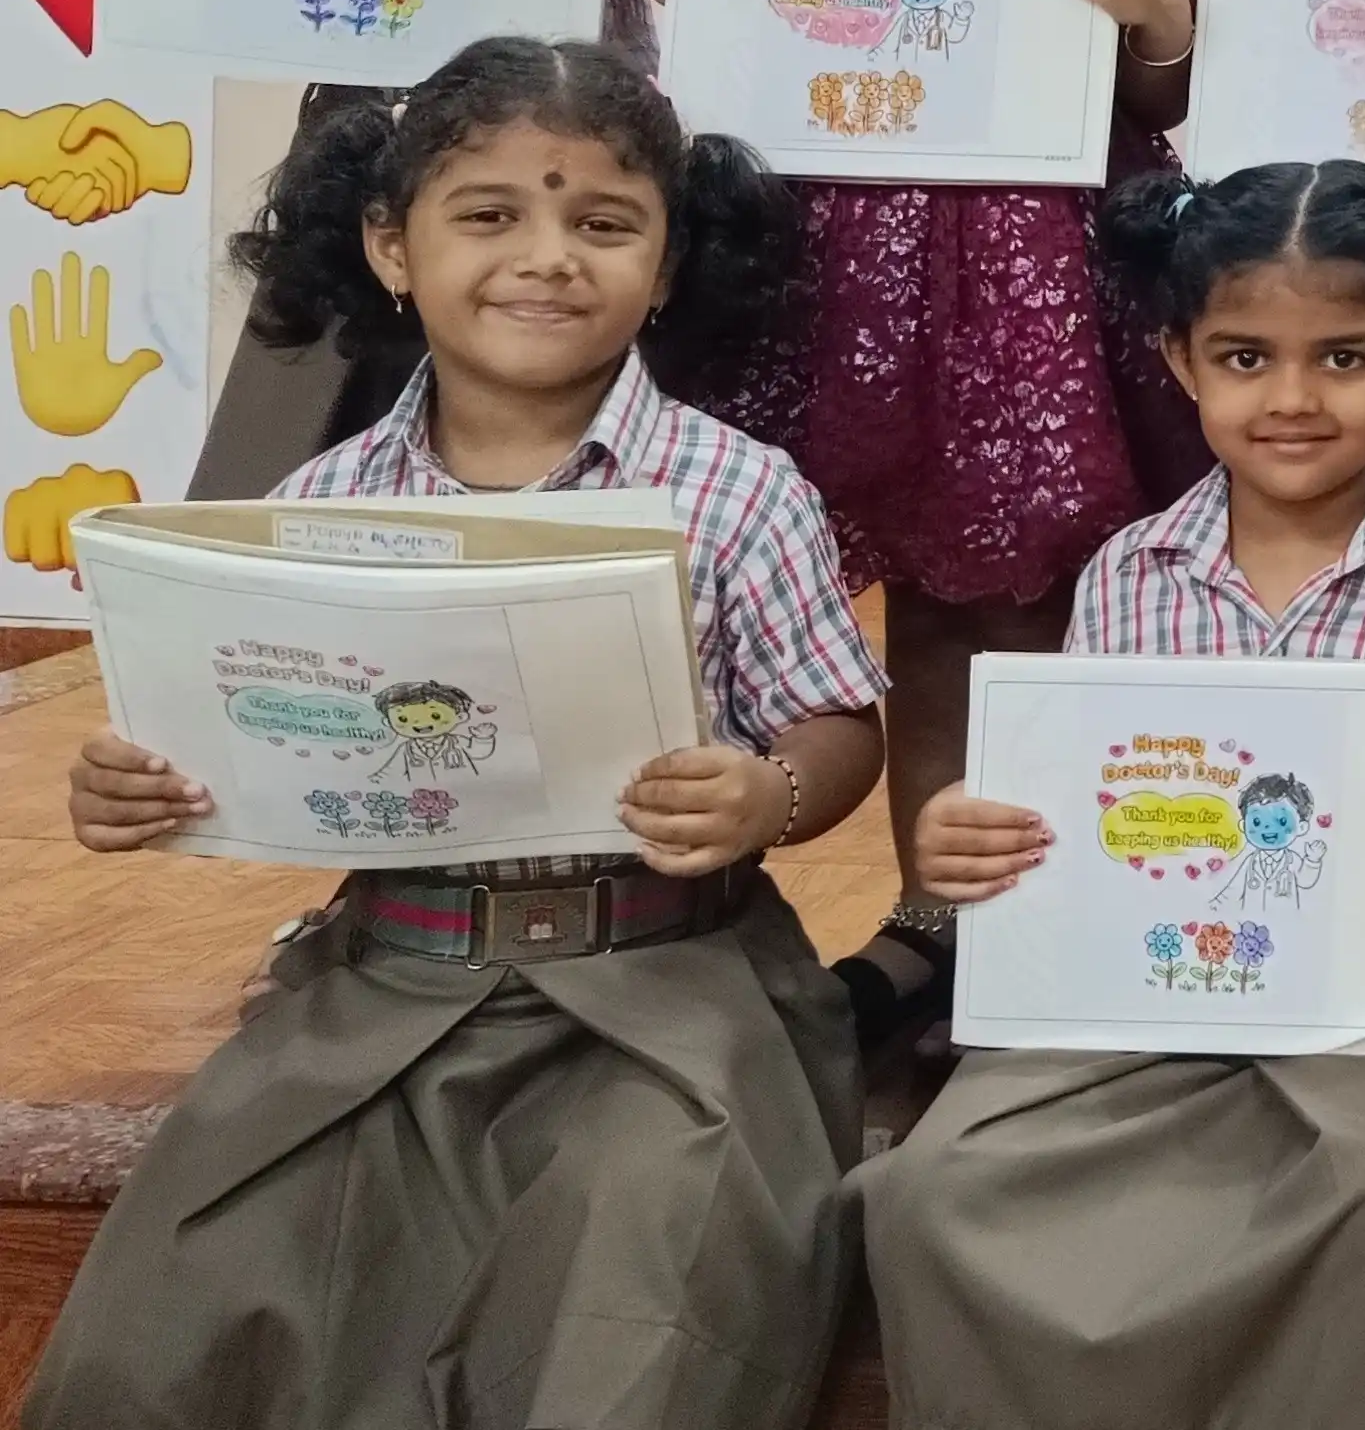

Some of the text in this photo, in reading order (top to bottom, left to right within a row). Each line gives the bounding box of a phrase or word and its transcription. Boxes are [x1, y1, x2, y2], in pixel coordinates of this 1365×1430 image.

[238, 639, 324, 668] Happy
[212, 659, 371, 694] Doctor's Day!
[247, 695, 361, 721] Thank you for
[1132, 733, 1206, 758] Happy
[1101, 761, 1241, 788] Doctor's Day!
[1121, 806, 1224, 826] Thank you for
[1106, 831, 1161, 849] keeping
[1163, 835, 1180, 847] us
